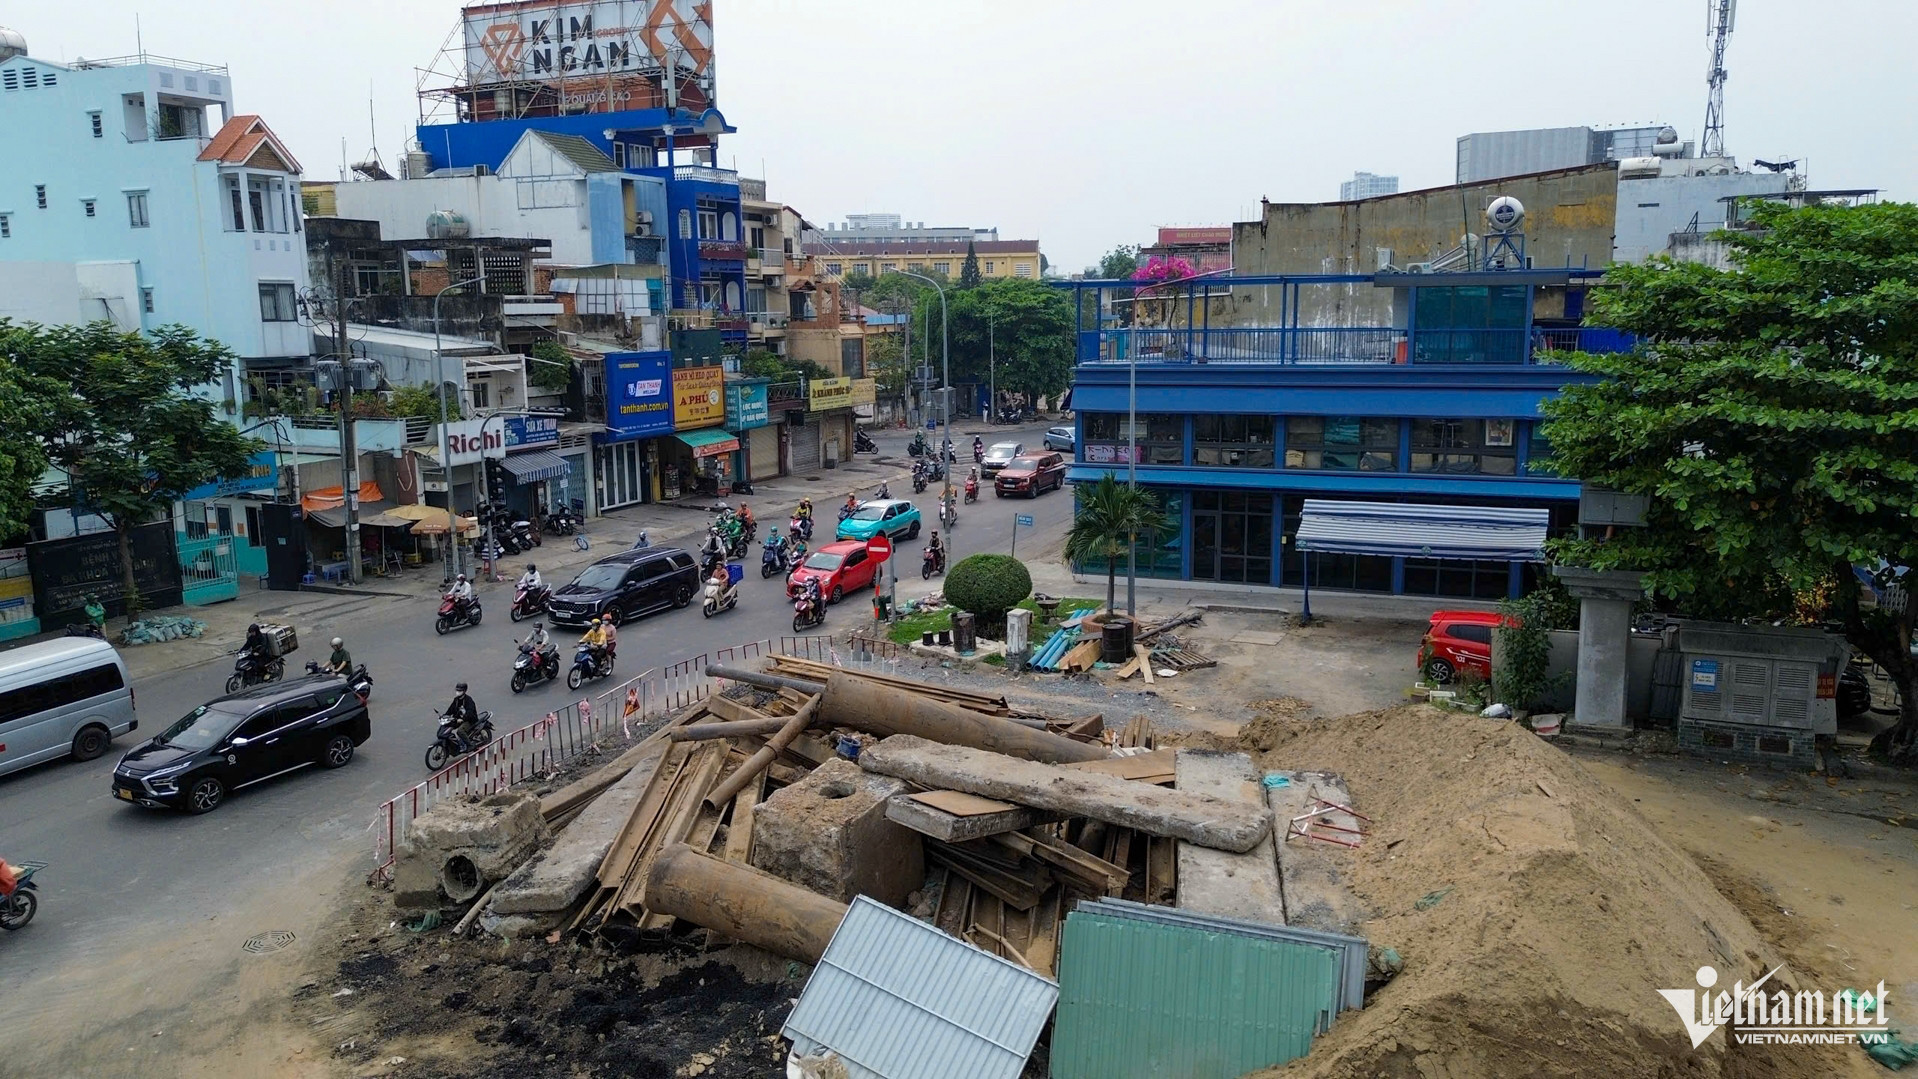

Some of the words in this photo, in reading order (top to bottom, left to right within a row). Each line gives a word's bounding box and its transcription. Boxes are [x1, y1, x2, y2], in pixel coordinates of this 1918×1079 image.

[532, 14, 593, 45] KIM
[596, 27, 629, 38] GROUP
[679, 396, 688, 407] A
[689, 391, 709, 405] PHÚ
[619, 402, 669, 415] tanthanh.com.vn
[447, 428, 502, 455] Richi
